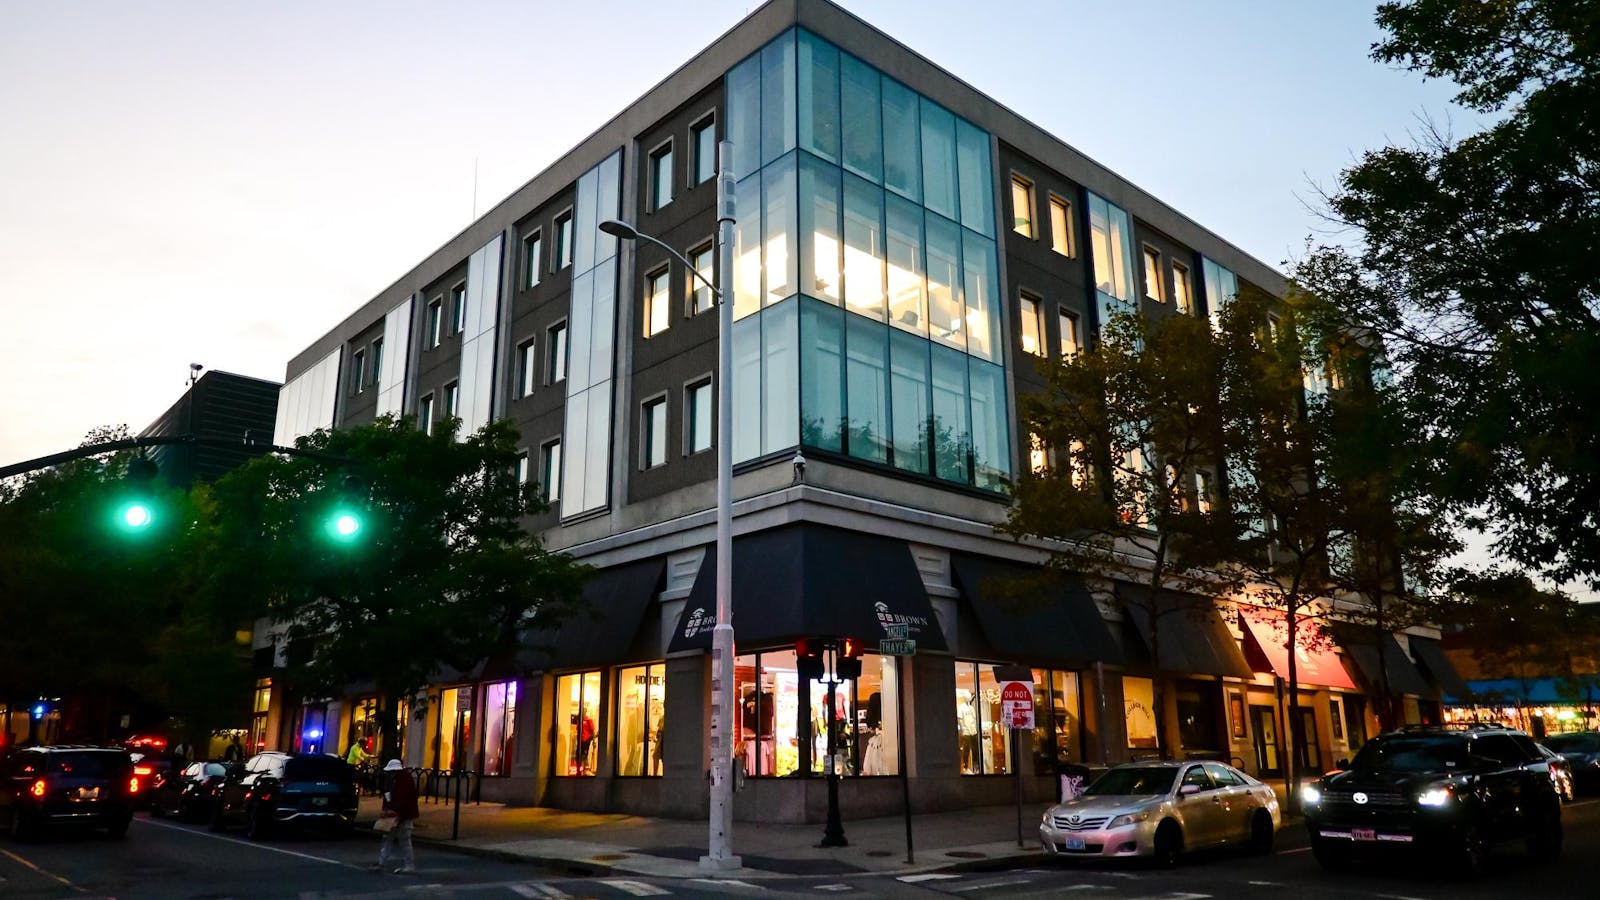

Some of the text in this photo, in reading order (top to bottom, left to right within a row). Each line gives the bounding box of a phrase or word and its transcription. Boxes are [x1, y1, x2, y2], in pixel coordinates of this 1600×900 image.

[894, 613, 928, 626] BROWN
[881, 641, 908, 654] THAYER
[635, 675, 660, 686] HODIE
[1015, 691, 1027, 699] NOT
